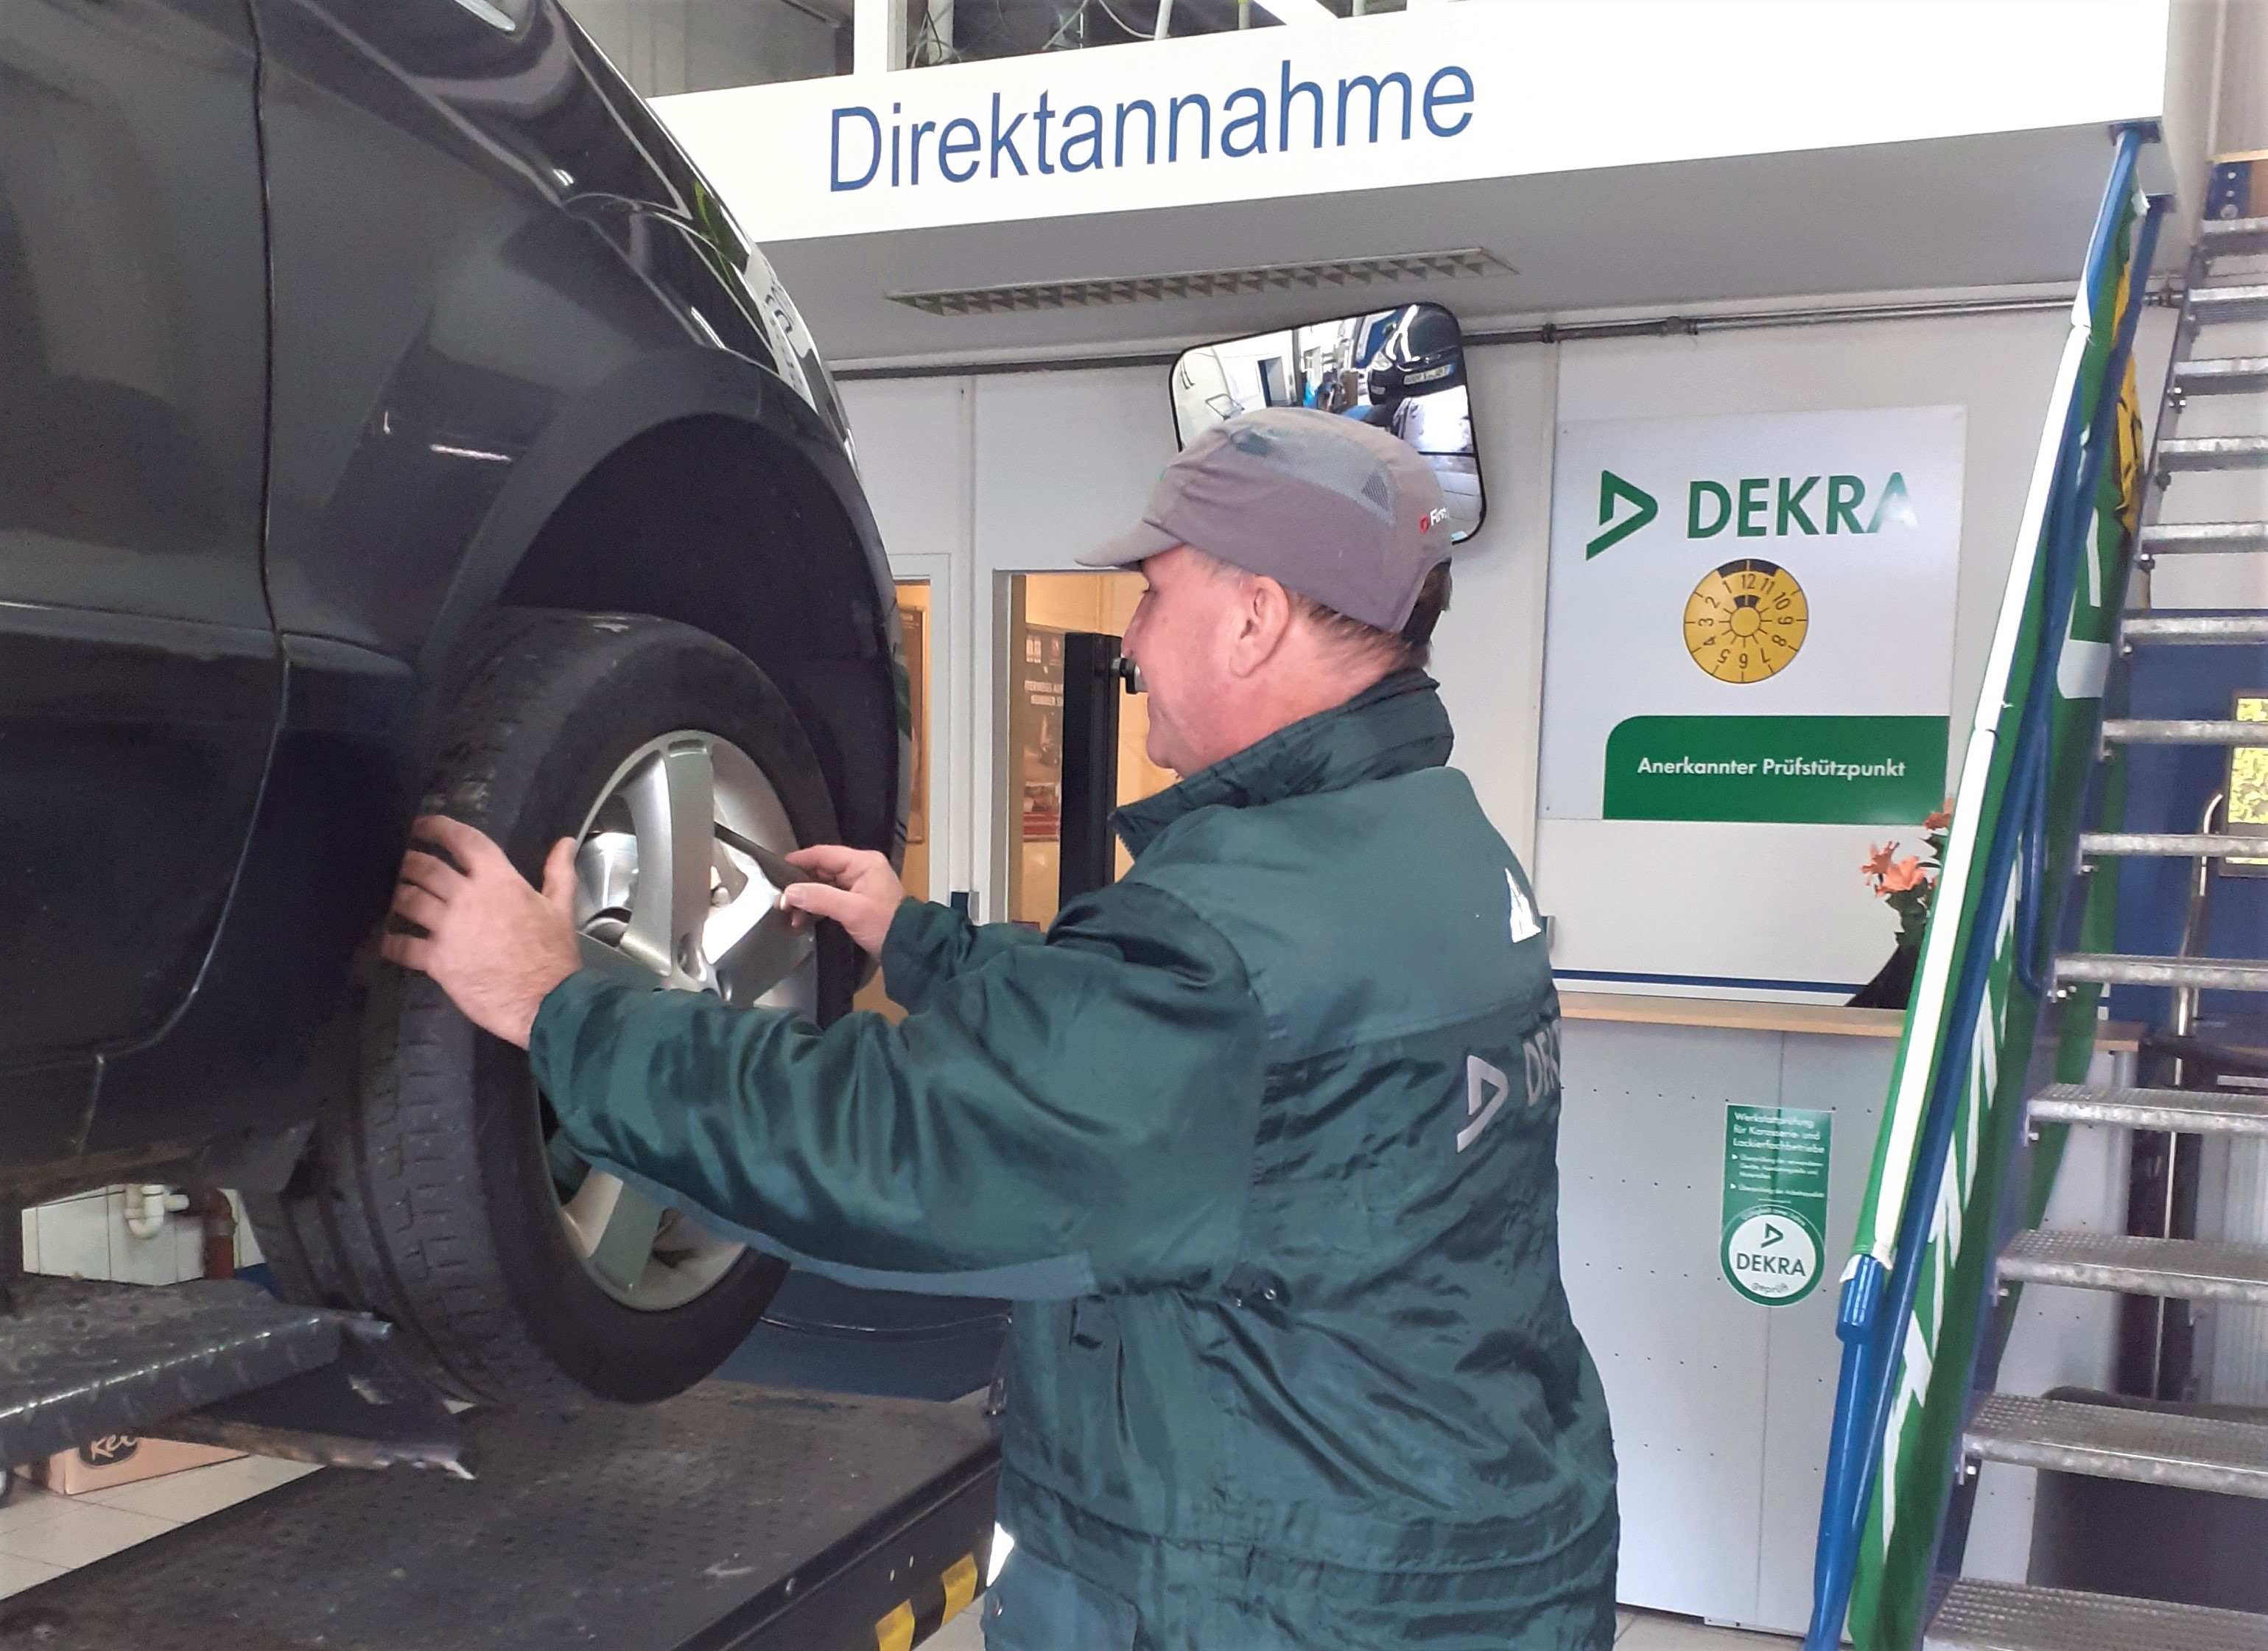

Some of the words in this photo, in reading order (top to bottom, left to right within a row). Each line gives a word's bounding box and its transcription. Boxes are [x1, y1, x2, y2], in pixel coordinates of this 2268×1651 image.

[830, 59, 1475, 193] Direktannahme
[1687, 472, 1917, 539] DEKRA
[1722, 580, 1732, 594] 1
[1741, 573, 1756, 589] 12
[1760, 578, 1774, 595] 11
[1704, 596, 1720, 609] 2
[1772, 592, 1791, 611] 10
[1698, 617, 1713, 626] 3
[1777, 616, 1794, 625] 9
[1702, 637, 1716, 646] 4
[1772, 634, 1787, 647] 8
[1717, 648, 1730, 663] 5
[1739, 653, 1748, 669] 6
[1760, 648, 1772, 663] 7
[1637, 756, 1758, 775] Anerkannter
[1763, 757, 1906, 782] Prüfstützpunkt
[1736, 1252, 1806, 1277] DEKRA
